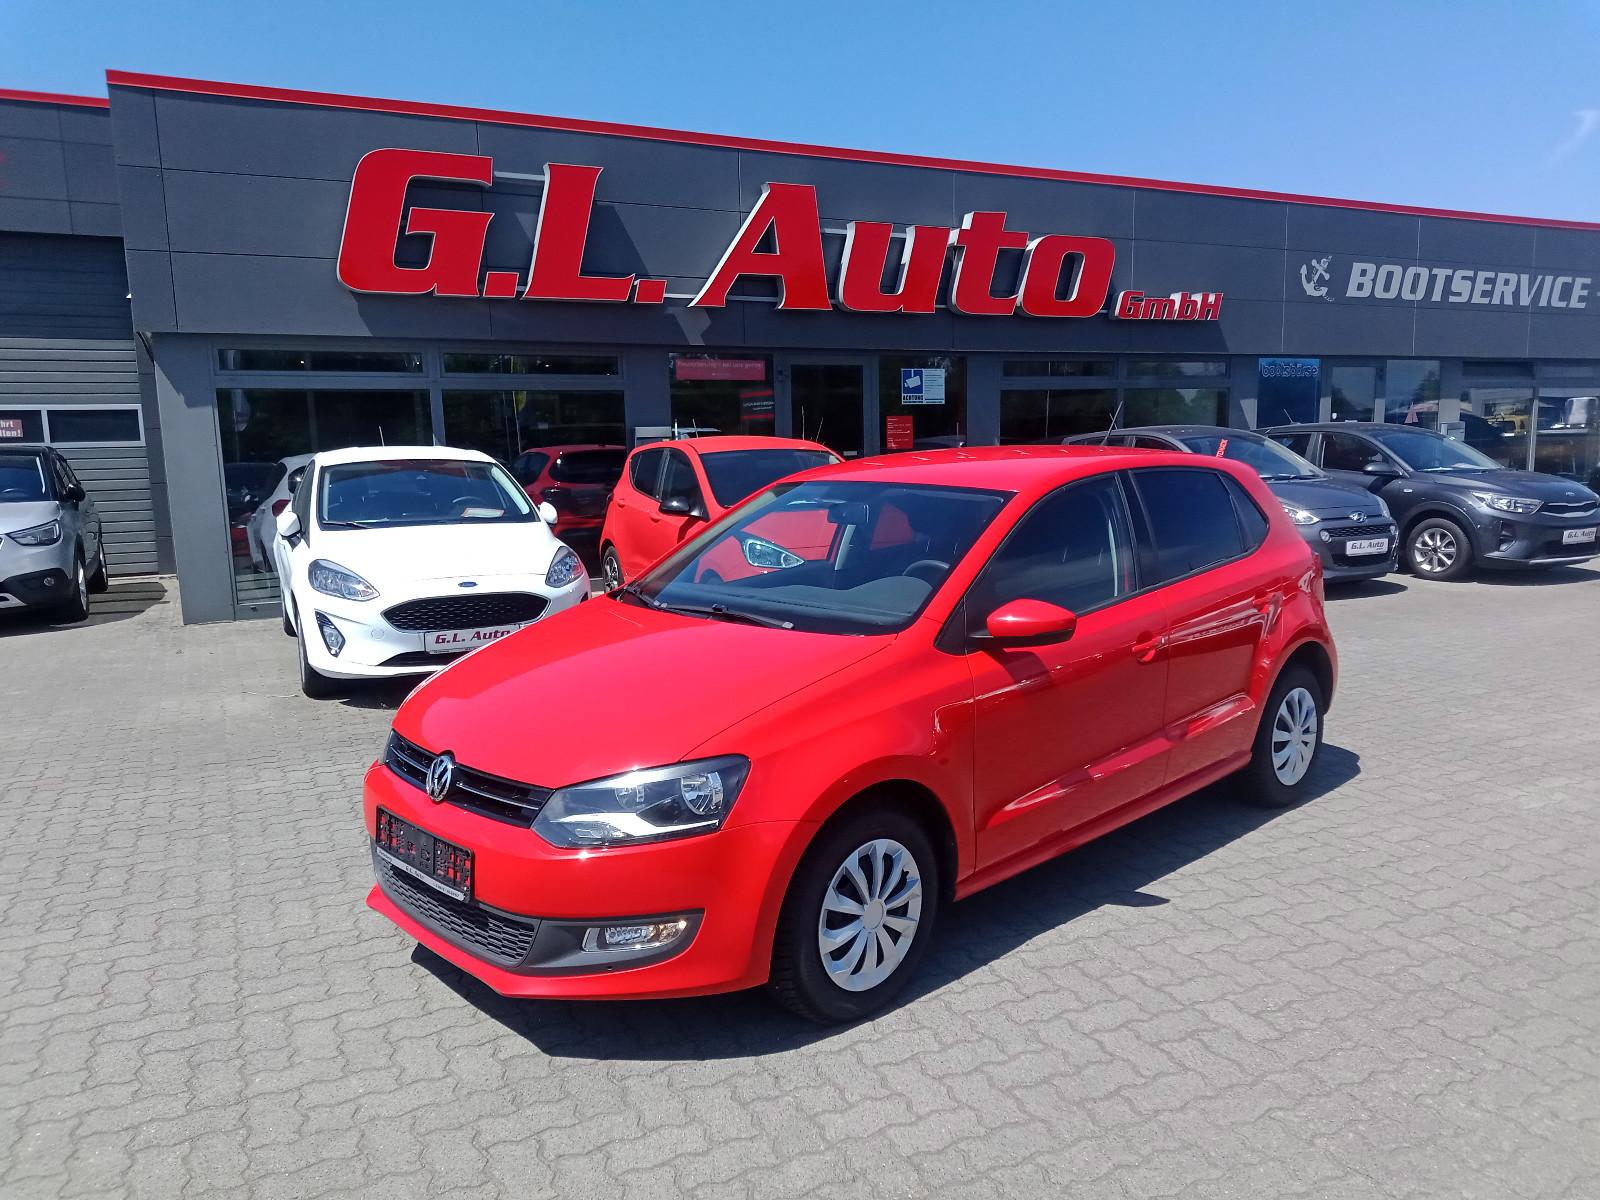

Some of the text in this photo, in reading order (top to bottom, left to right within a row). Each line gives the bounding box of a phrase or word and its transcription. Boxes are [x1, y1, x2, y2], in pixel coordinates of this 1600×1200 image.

[337, 147, 1223, 321] G.L. Auto GmbH
[1346, 262, 1591, 308] BOOTSERVICE
[435, 633, 466, 644] G.L.
